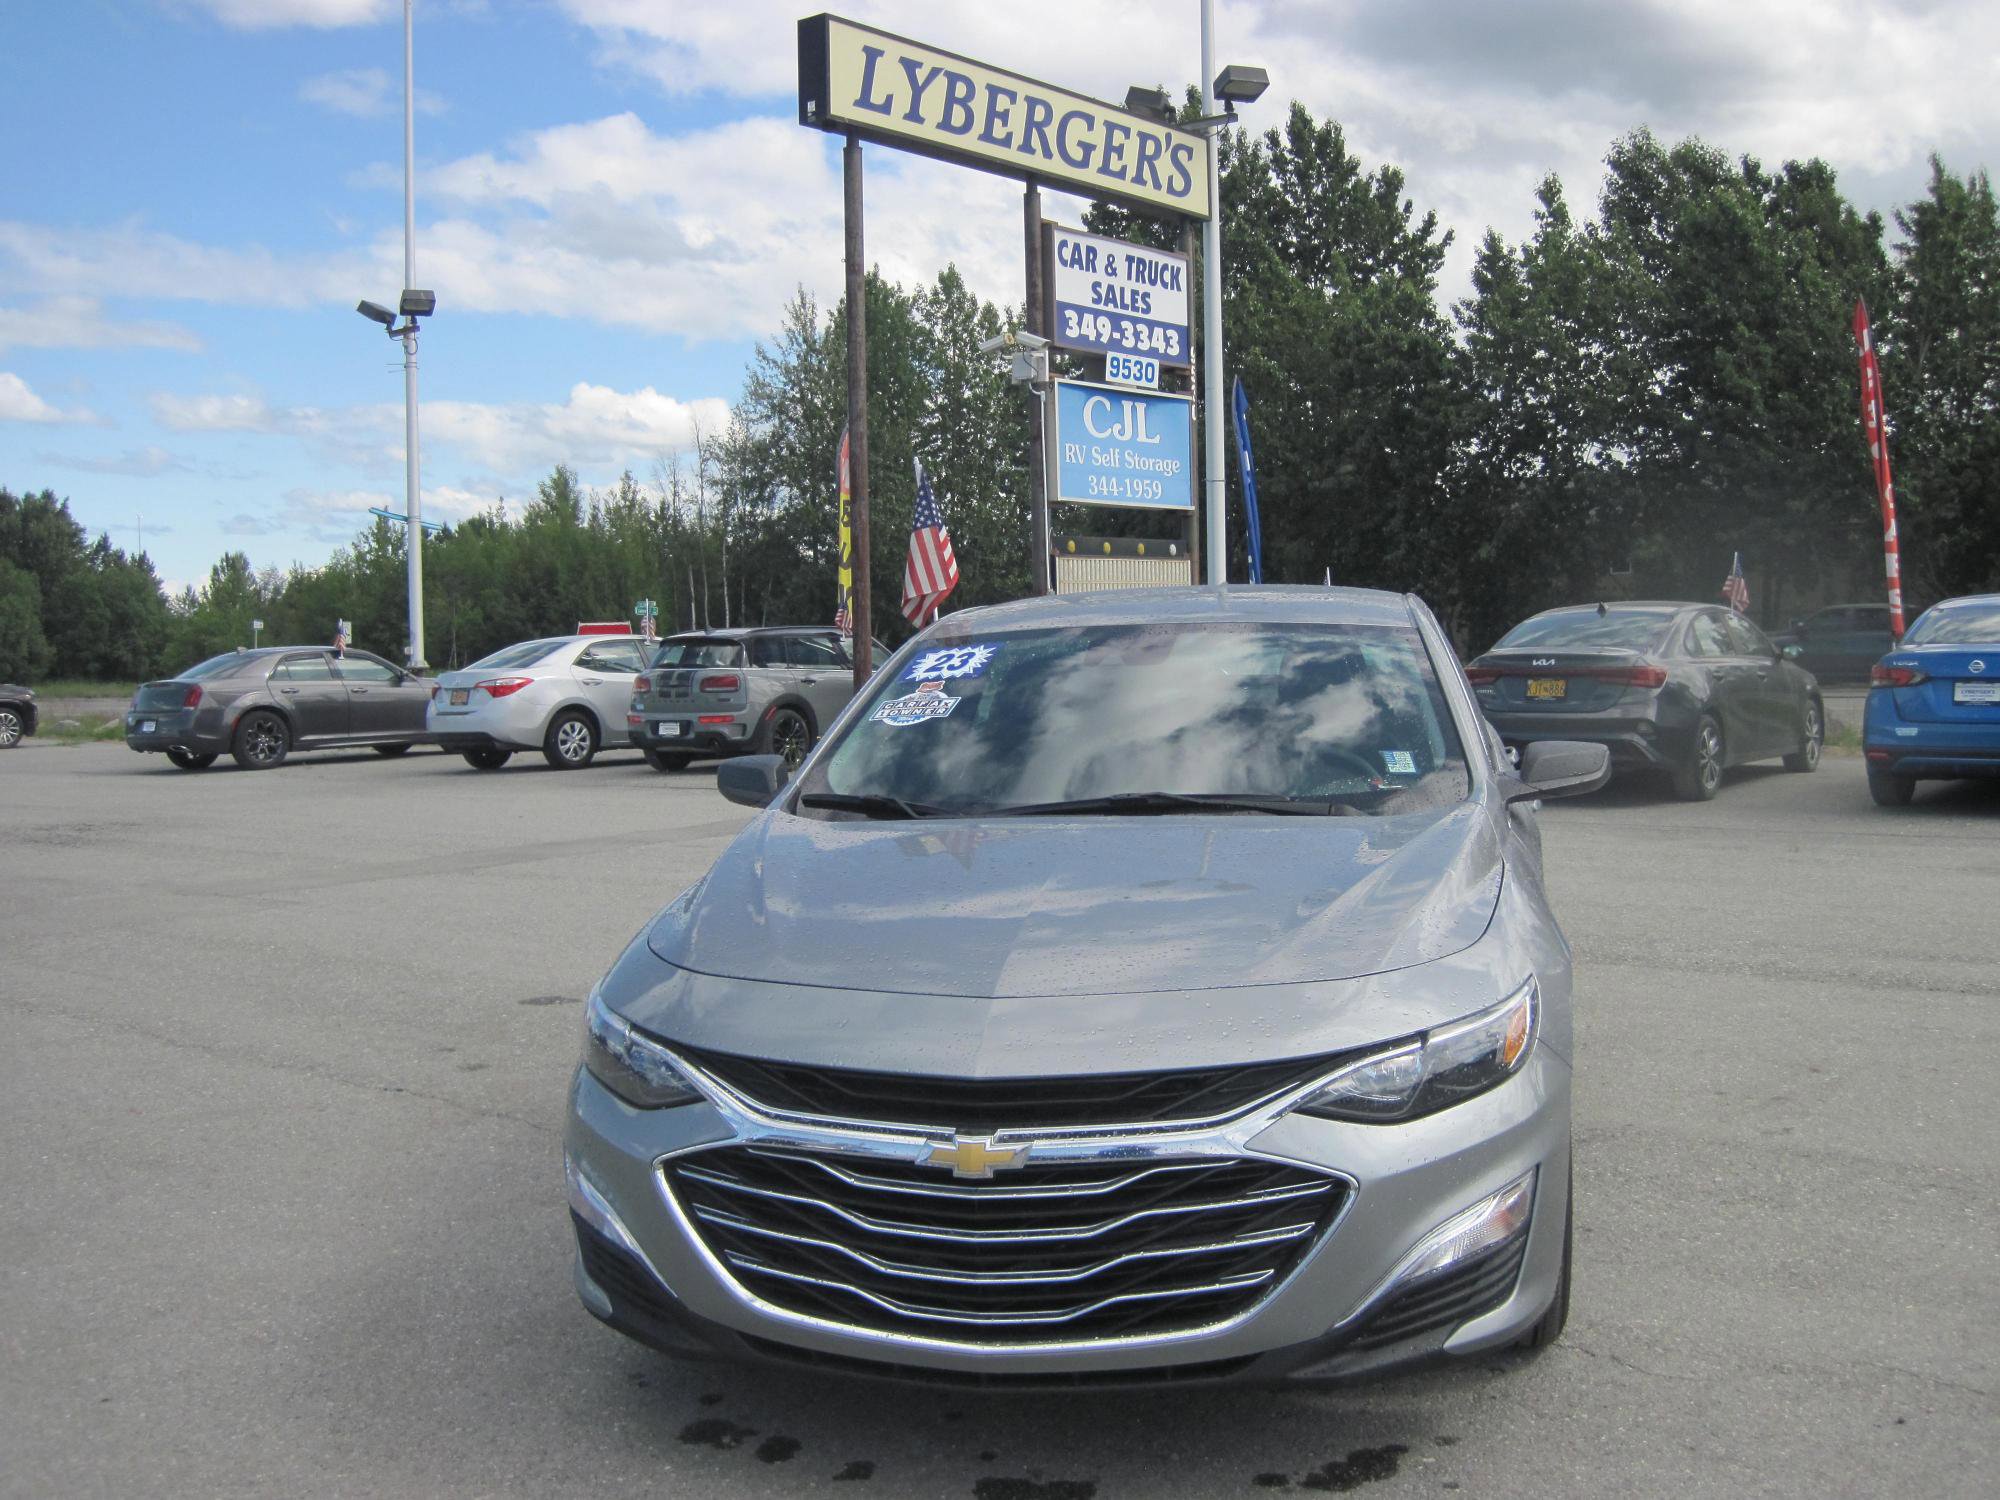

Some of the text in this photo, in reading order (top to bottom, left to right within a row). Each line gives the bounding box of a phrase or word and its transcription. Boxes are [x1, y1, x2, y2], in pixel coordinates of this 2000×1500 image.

[853, 45, 1193, 198] LYBERGER'S
[1057, 239, 1182, 292] CAR & TRUCK
[1091, 281, 1152, 315] SALES
[1064, 309, 1180, 356] 349-3343
[1109, 356, 1156, 383] 9530
[1083, 395, 1161, 444] CJL
[1065, 443, 1181, 476] RV Self Storage
[1088, 475, 1162, 500] 344-1959
[923, 652, 976, 673] 23
[1532, 658, 1556, 666] KIA
[884, 699, 952, 709] CARFAX
[889, 708, 946, 716] OWNER
